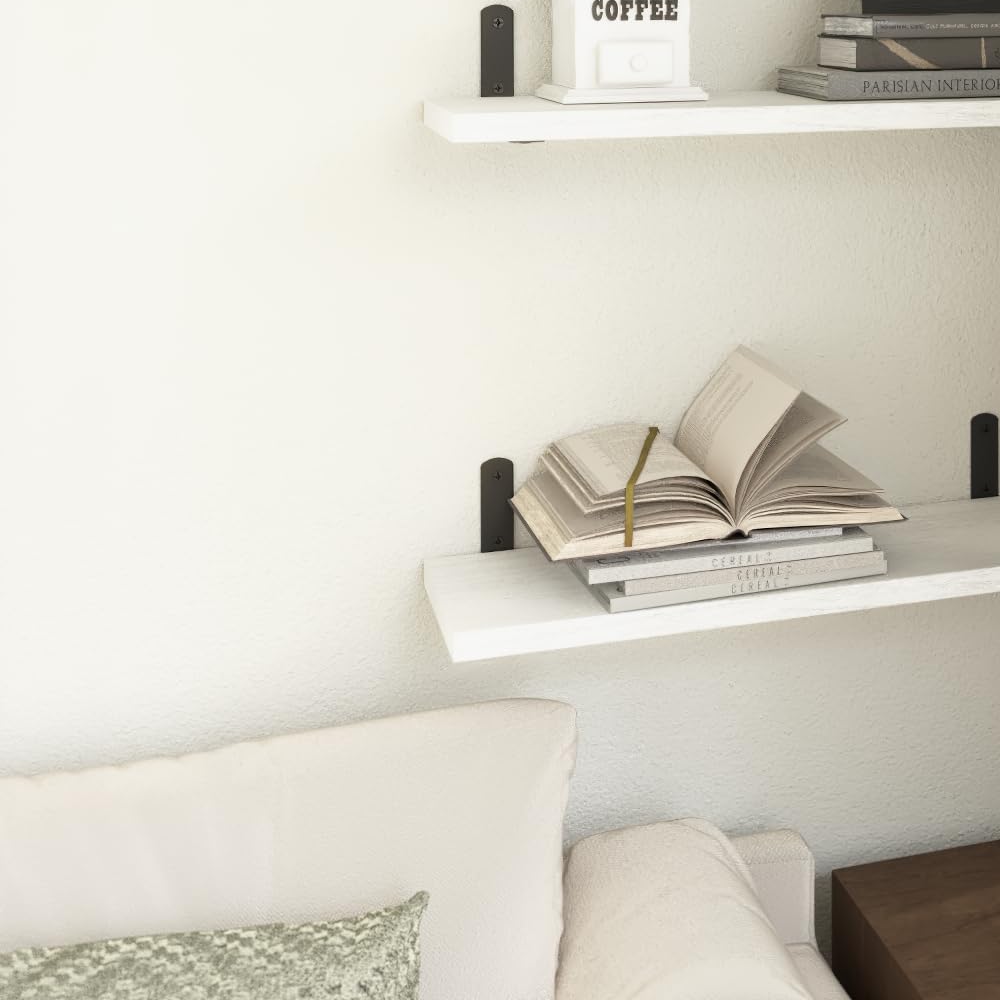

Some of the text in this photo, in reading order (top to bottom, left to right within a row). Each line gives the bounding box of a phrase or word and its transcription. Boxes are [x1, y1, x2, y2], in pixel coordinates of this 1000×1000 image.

[592, 0, 679, 21] COFFEE
[863, 79, 932, 93] PARISIAN
[711, 554, 760, 568] CEREAL
[737, 565, 782, 581] CEREAL
[731, 579, 780, 594] CEREAL
